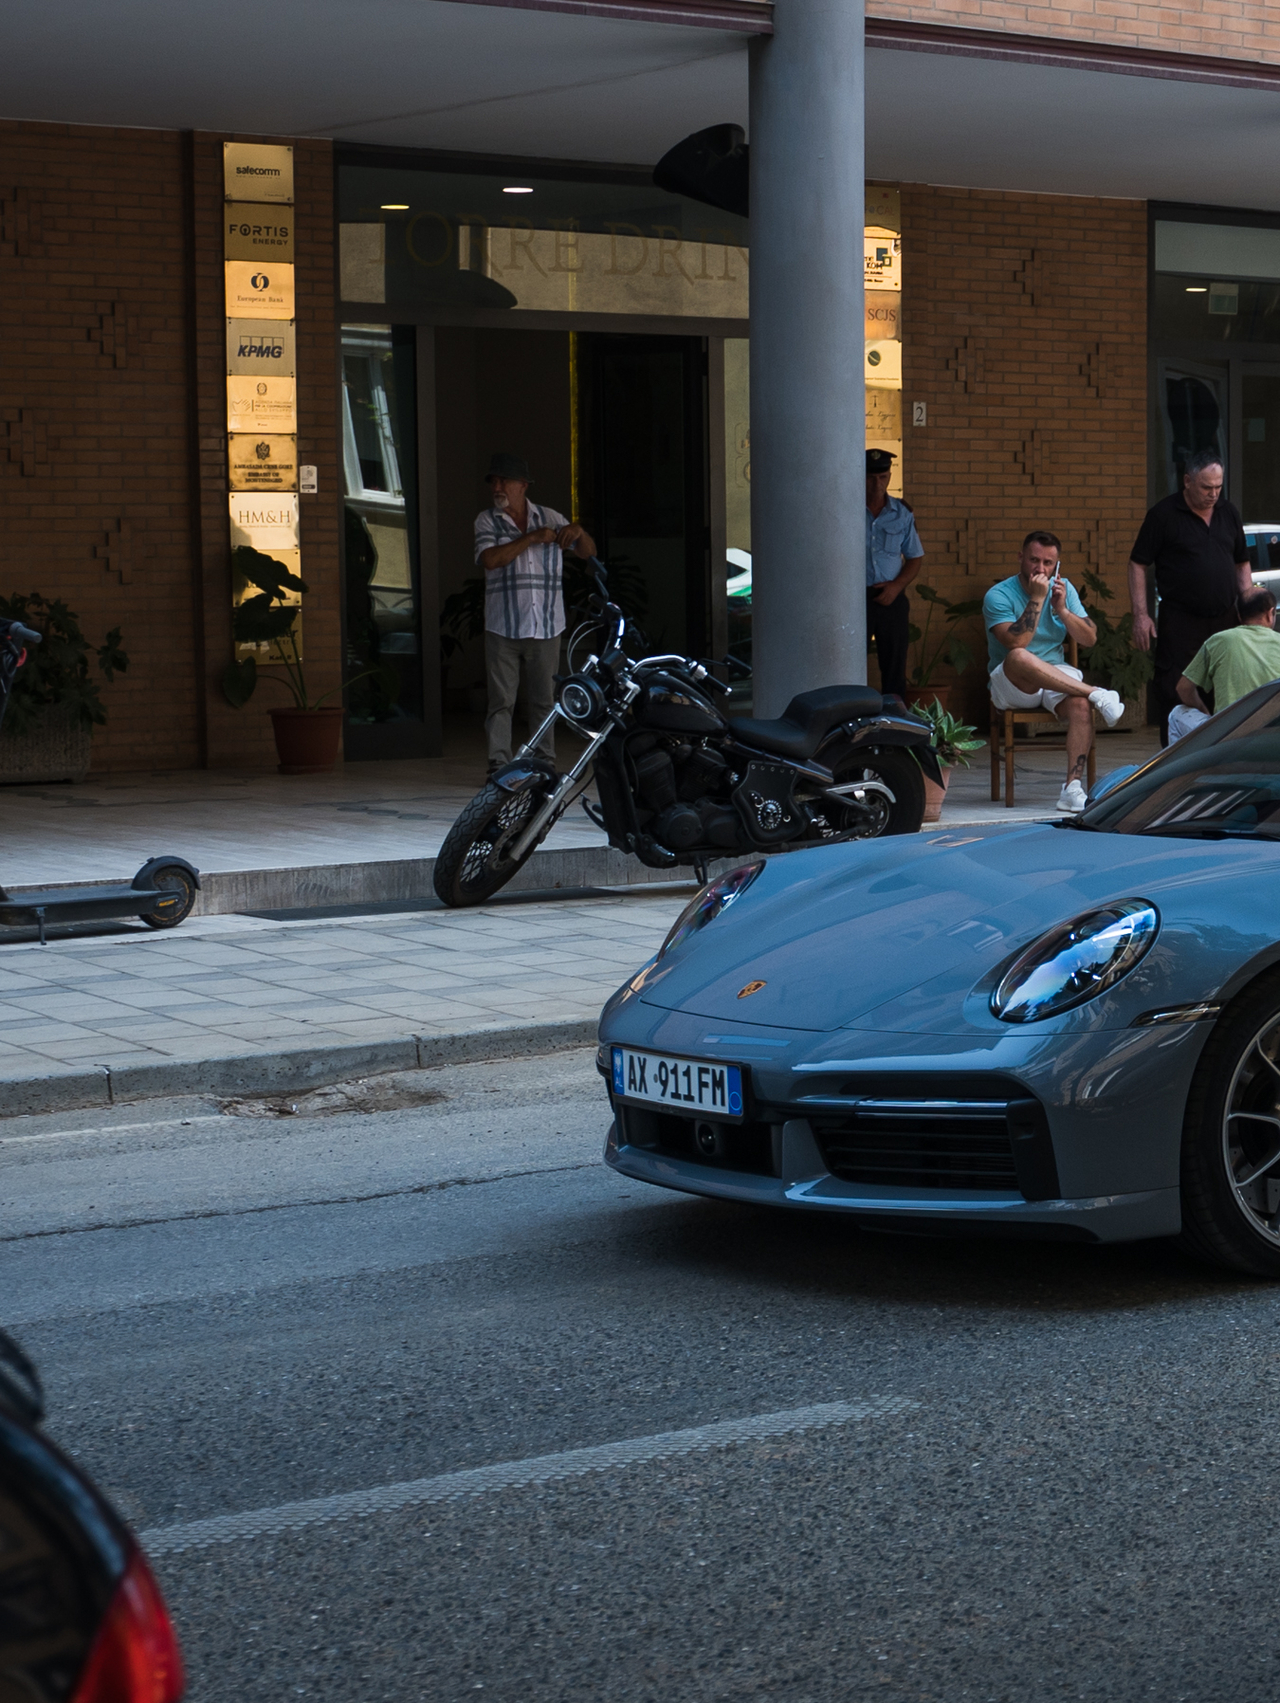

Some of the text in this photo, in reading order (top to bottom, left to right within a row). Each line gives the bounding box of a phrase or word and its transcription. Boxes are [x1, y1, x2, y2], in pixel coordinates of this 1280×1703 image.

[229, 223, 289, 237] FORTIS
[252, 238, 289, 246] ENERGY
[358, 207, 585, 279] TORRE
[237, 295, 266, 303] European
[237, 345, 283, 359] KPMG
[915, 406, 924, 422] 2
[239, 510, 291, 524] HM&H
[628, 1055, 649, 1095] AX
